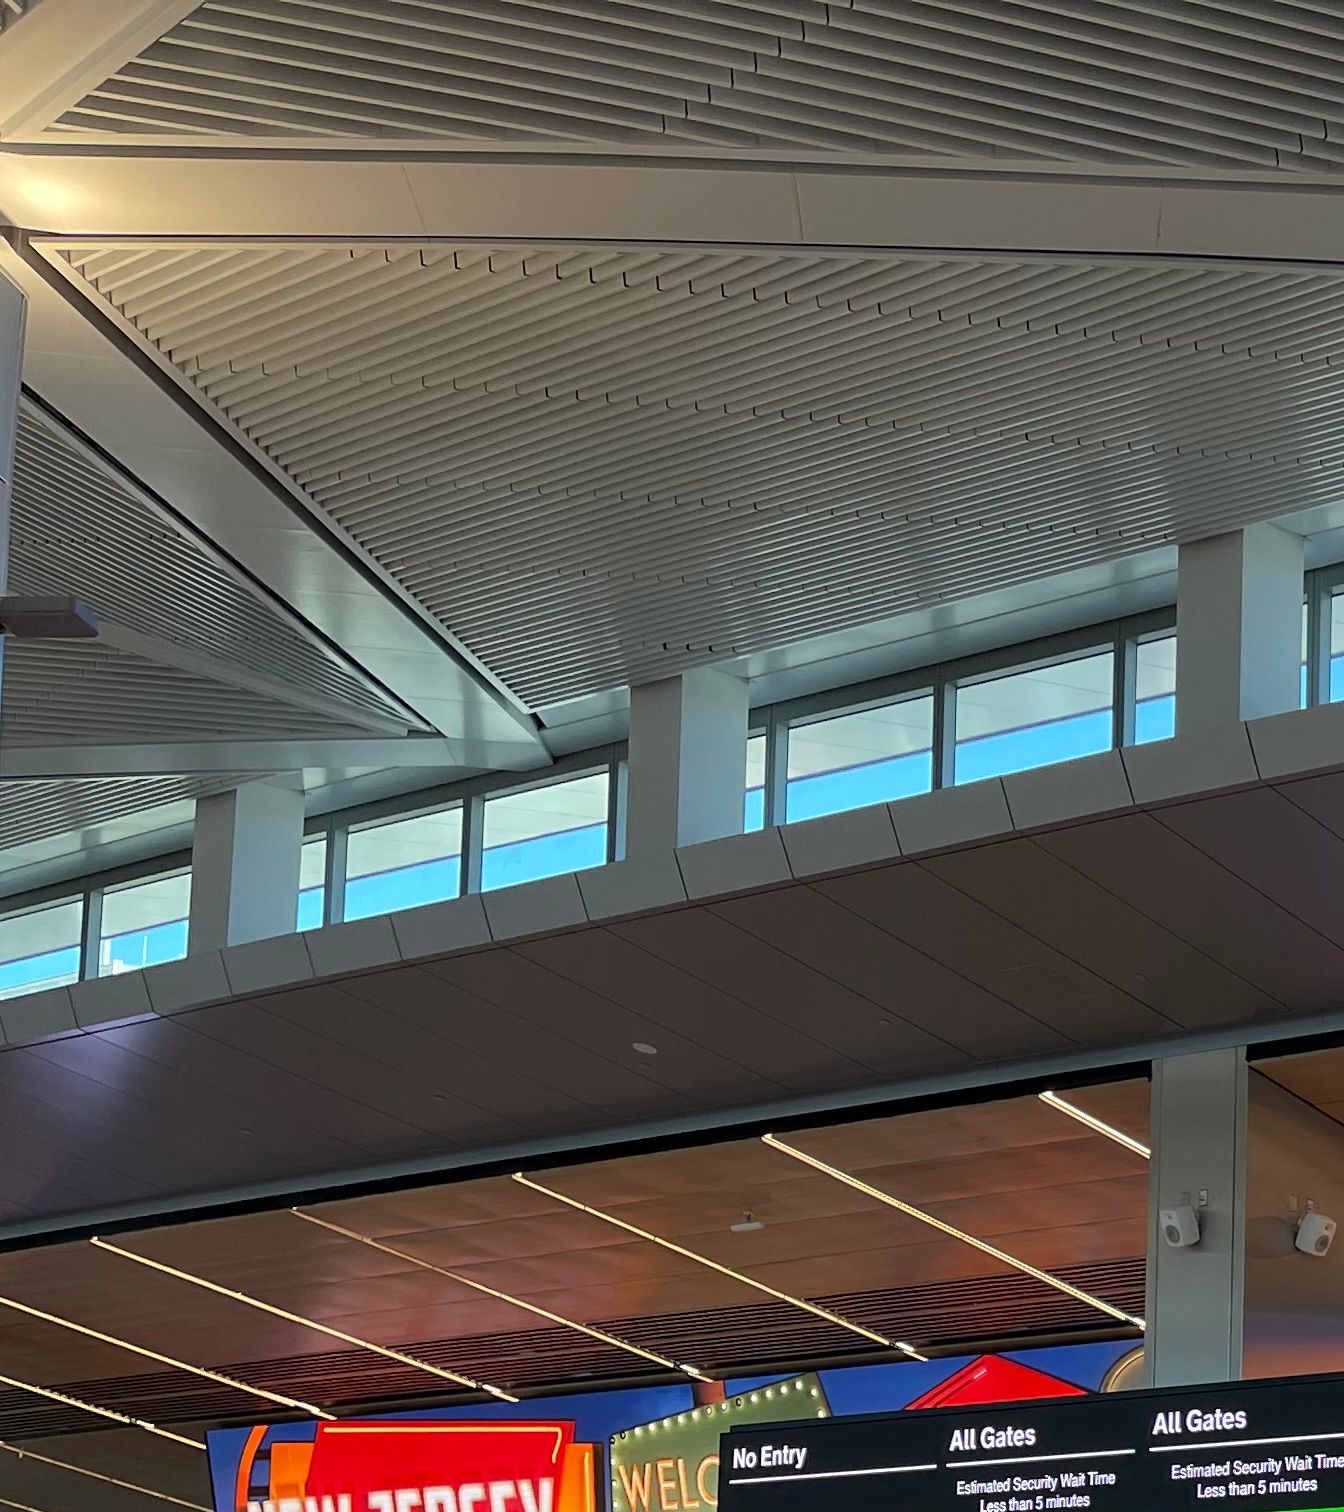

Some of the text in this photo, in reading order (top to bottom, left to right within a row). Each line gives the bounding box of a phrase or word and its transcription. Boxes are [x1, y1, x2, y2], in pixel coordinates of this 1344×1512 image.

[1152, 1409, 1247, 1435] All Gates
[949, 1426, 1036, 1451] All Gates
[733, 1445, 807, 1469] No Entry
[1171, 1454, 1344, 1480] Estimated Security Wait Time
[957, 1471, 1116, 1496] Estimated Security Wait Time
[1197, 1478, 1318, 1498] Less than 5 minutes
[980, 1494, 1090, 1512] Less than 5 minutes
